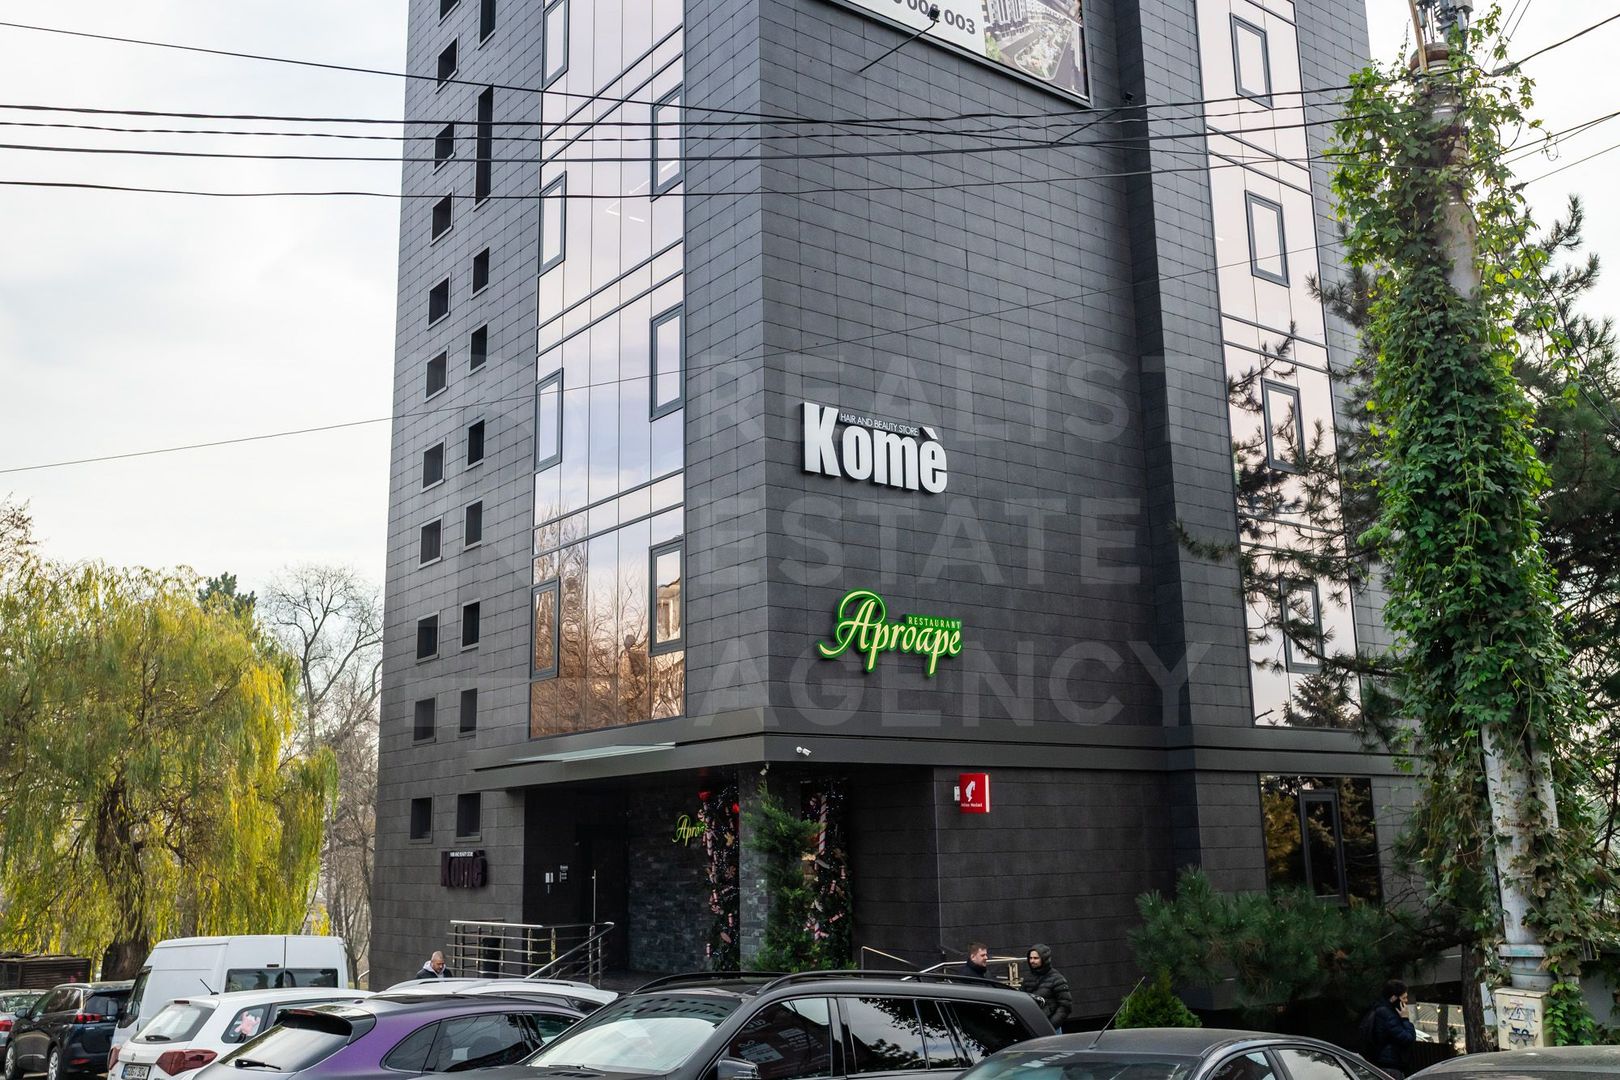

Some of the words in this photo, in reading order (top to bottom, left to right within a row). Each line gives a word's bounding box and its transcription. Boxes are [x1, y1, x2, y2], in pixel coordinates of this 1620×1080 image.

[944, 9, 976, 35] 003
[840, 413, 856, 425] HAIR
[857, 416, 873, 427] AND
[874, 419, 898, 432] BEAUTY
[898, 424, 919, 437] STORE
[804, 402, 948, 494] Komè
[819, 589, 962, 675] Aproape
[908, 616, 962, 629] RESTAURANT
[671, 814, 704, 847] Apro
